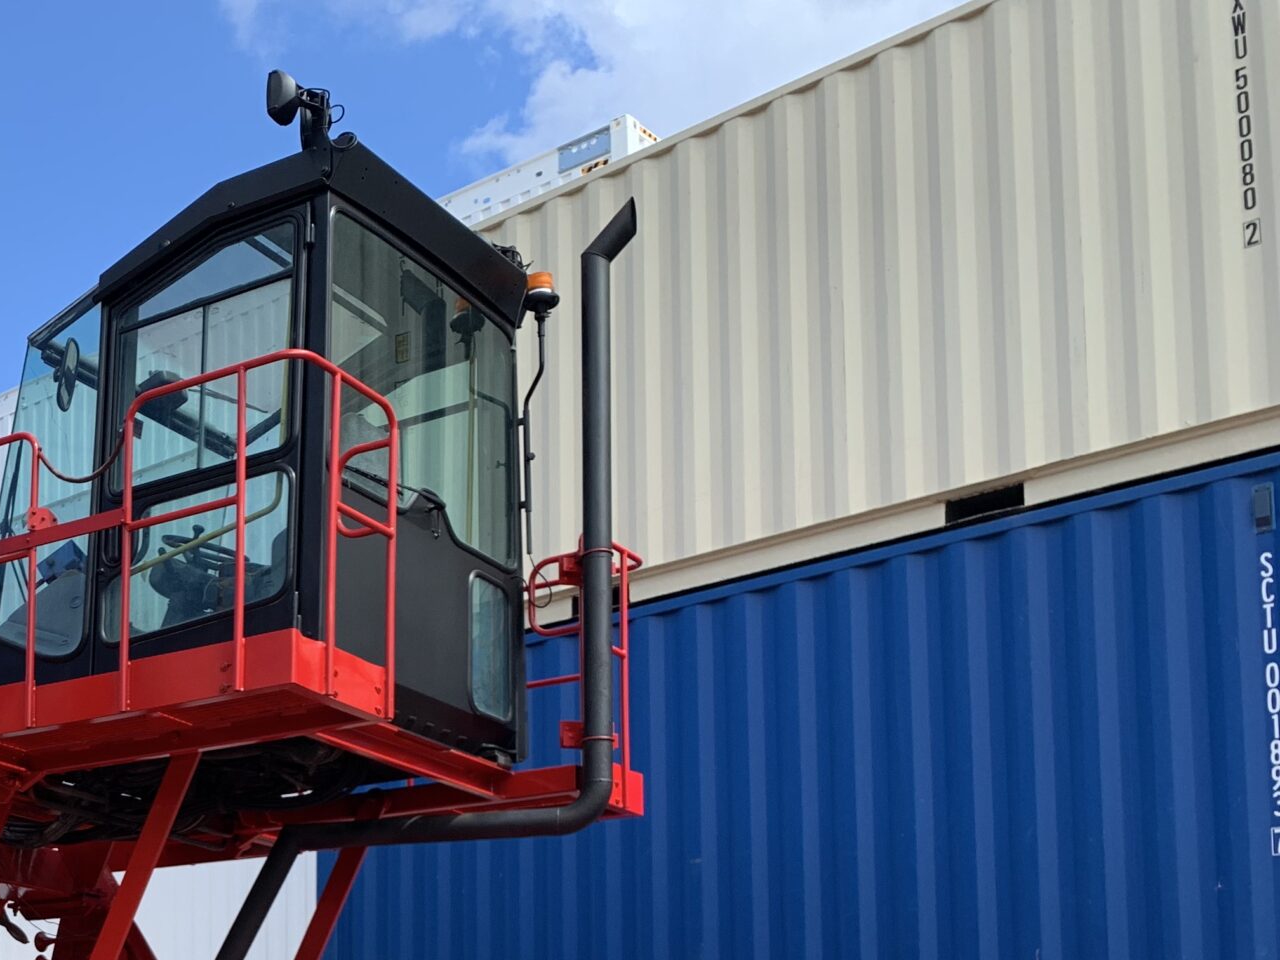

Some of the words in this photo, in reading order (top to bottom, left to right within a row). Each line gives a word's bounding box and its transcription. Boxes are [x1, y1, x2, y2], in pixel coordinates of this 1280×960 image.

[1235, 66, 1257, 211] 500080
[1245, 222, 1259, 246] 2
[1260, 552, 1277, 654] SCTU
